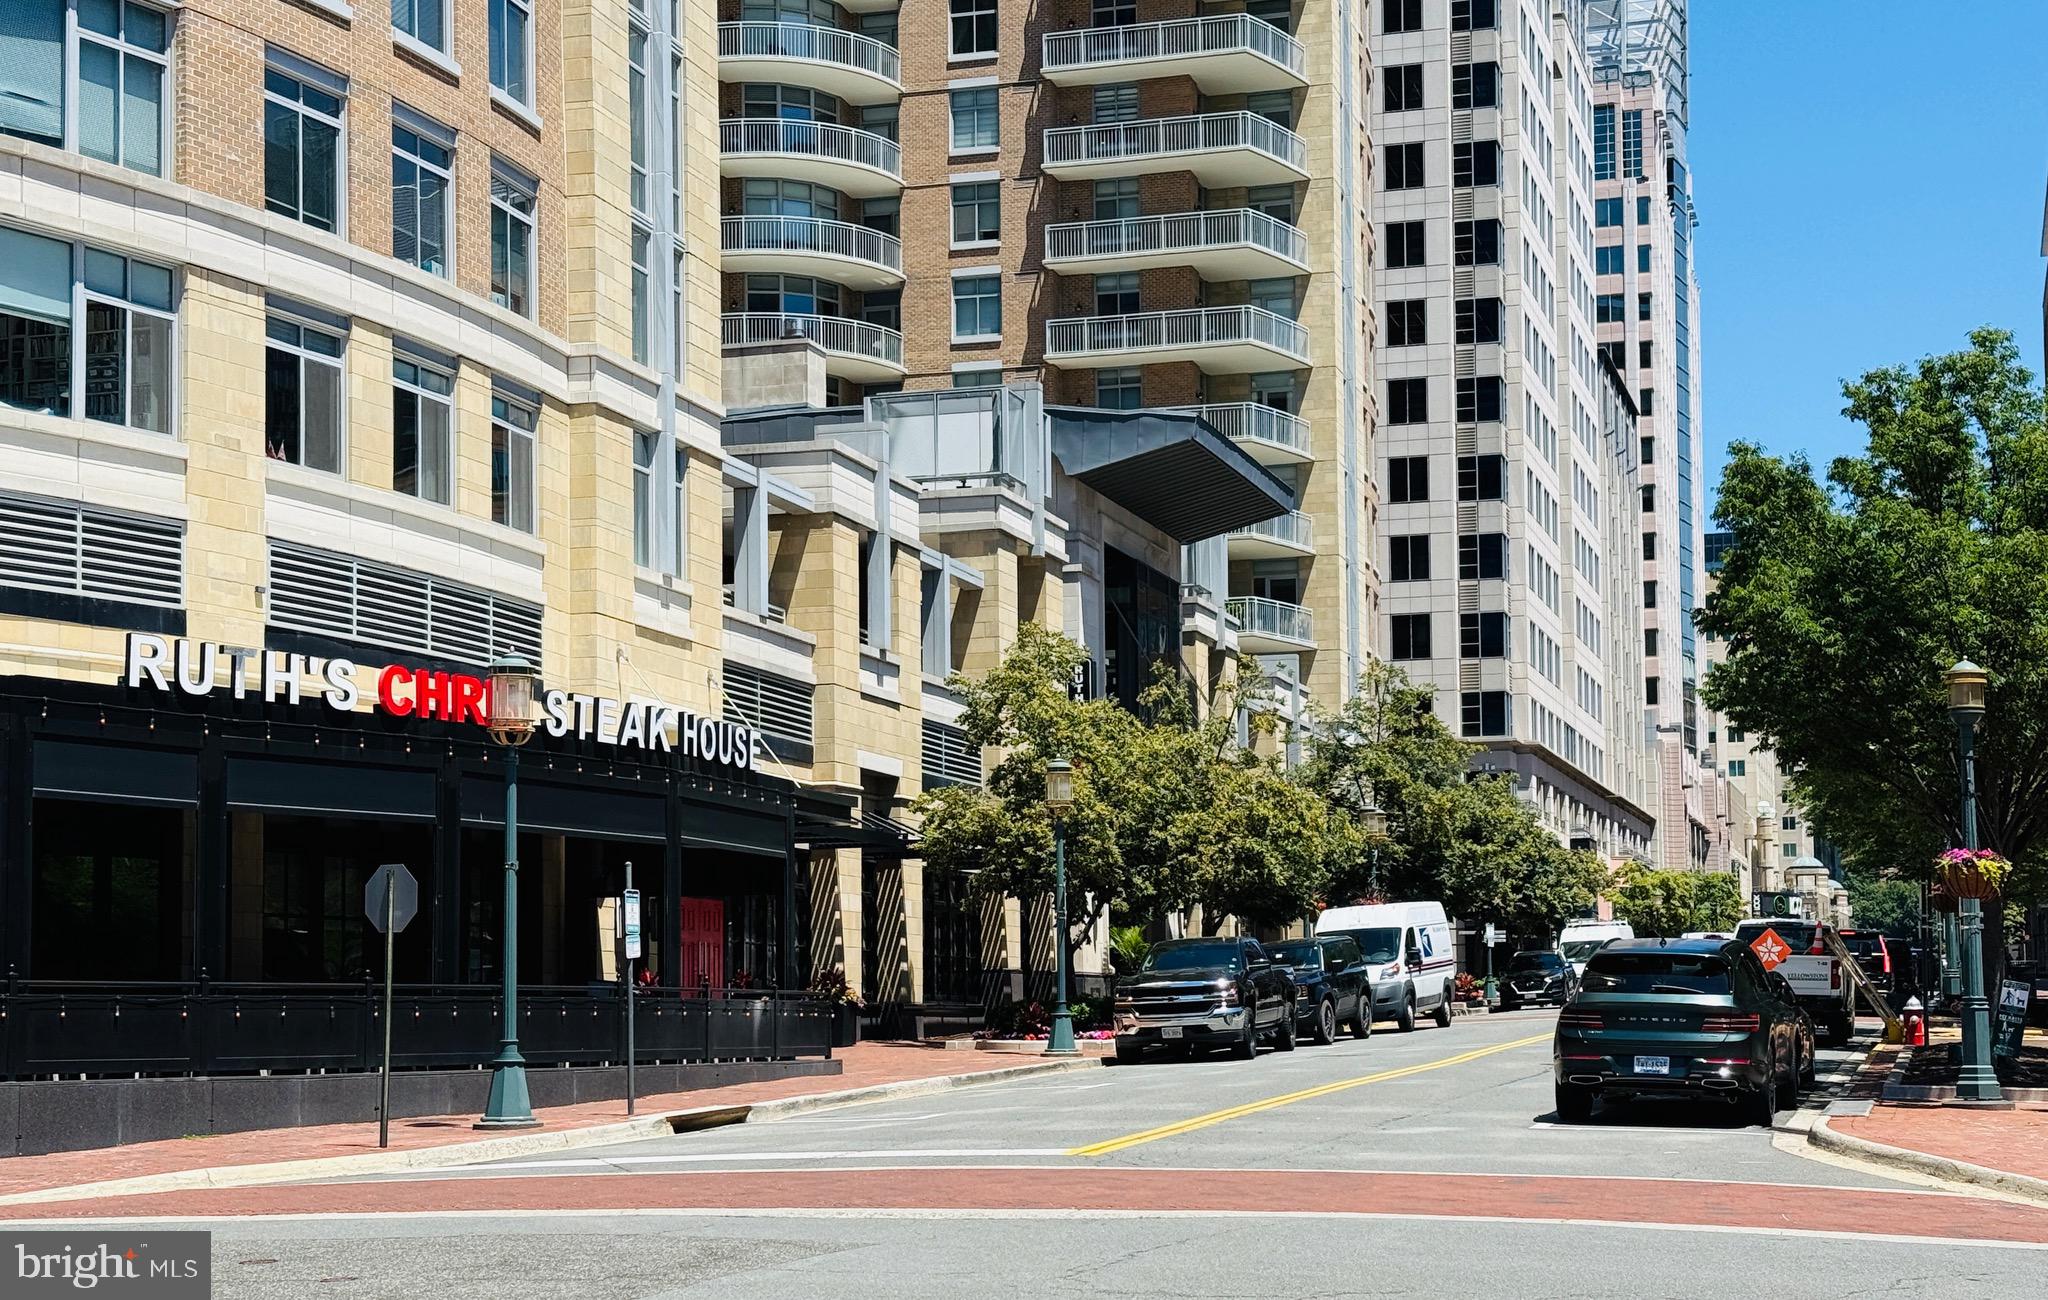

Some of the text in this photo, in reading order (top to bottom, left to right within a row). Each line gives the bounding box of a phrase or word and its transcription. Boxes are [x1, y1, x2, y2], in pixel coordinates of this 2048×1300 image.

[126, 632, 761, 773] RUTH'S CHR STEAK HOUSE
